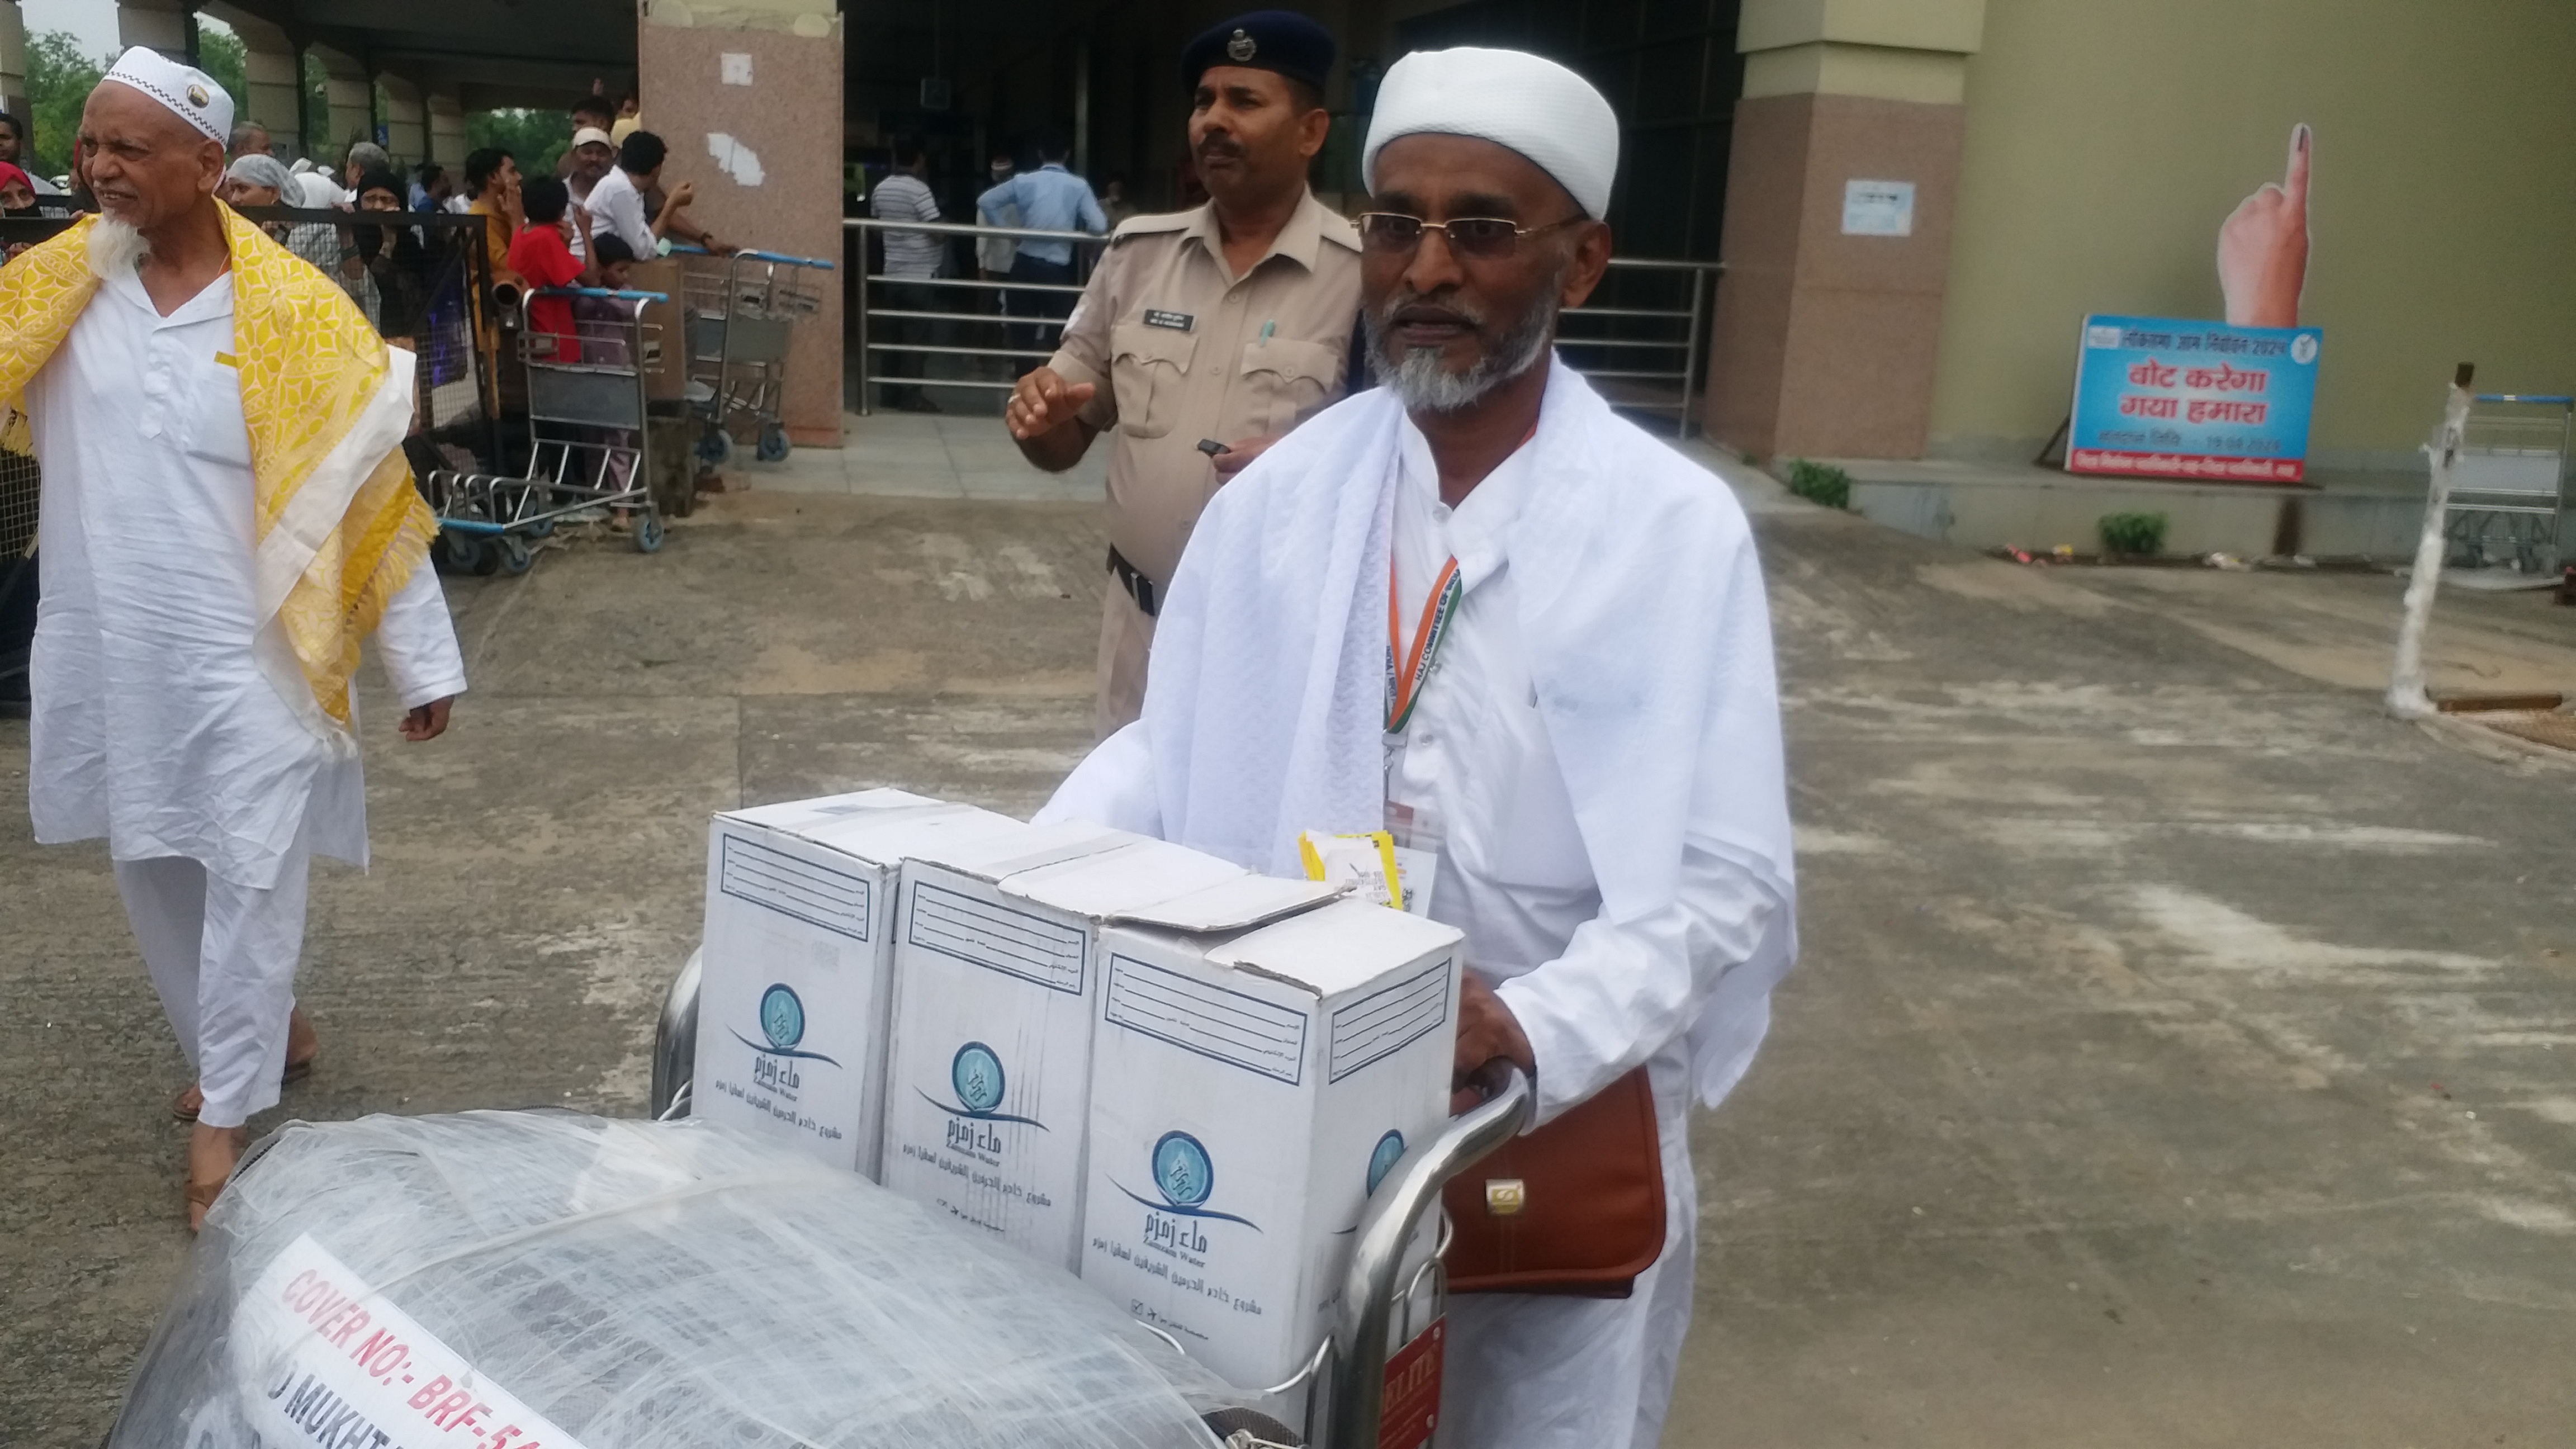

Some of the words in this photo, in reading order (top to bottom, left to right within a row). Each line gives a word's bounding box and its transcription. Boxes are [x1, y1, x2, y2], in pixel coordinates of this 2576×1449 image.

[2129, 358, 2177, 387] वोट
[2185, 361, 2269, 394] करेगा
[2119, 395, 2177, 419] गया
[2186, 399, 2269, 424] हमारा
[1415, 663, 1426, 681] HAJ
[1422, 608, 1445, 660] COMMITTEE
[755, 1052, 778, 1085] زمزم
[779, 1060, 800, 1089] ماء
[947, 1116, 974, 1150] زمزم
[977, 1123, 1001, 1154] ماء
[1145, 1210, 1176, 1248] زمزم
[1178, 1219, 1208, 1253] ماء
[1180, 1251, 1206, 1268] Water
[281, 1268, 371, 1350] COVER
[406, 1374, 541, 1449] BRF-5
[284, 1373, 405, 1449] MUKHT
